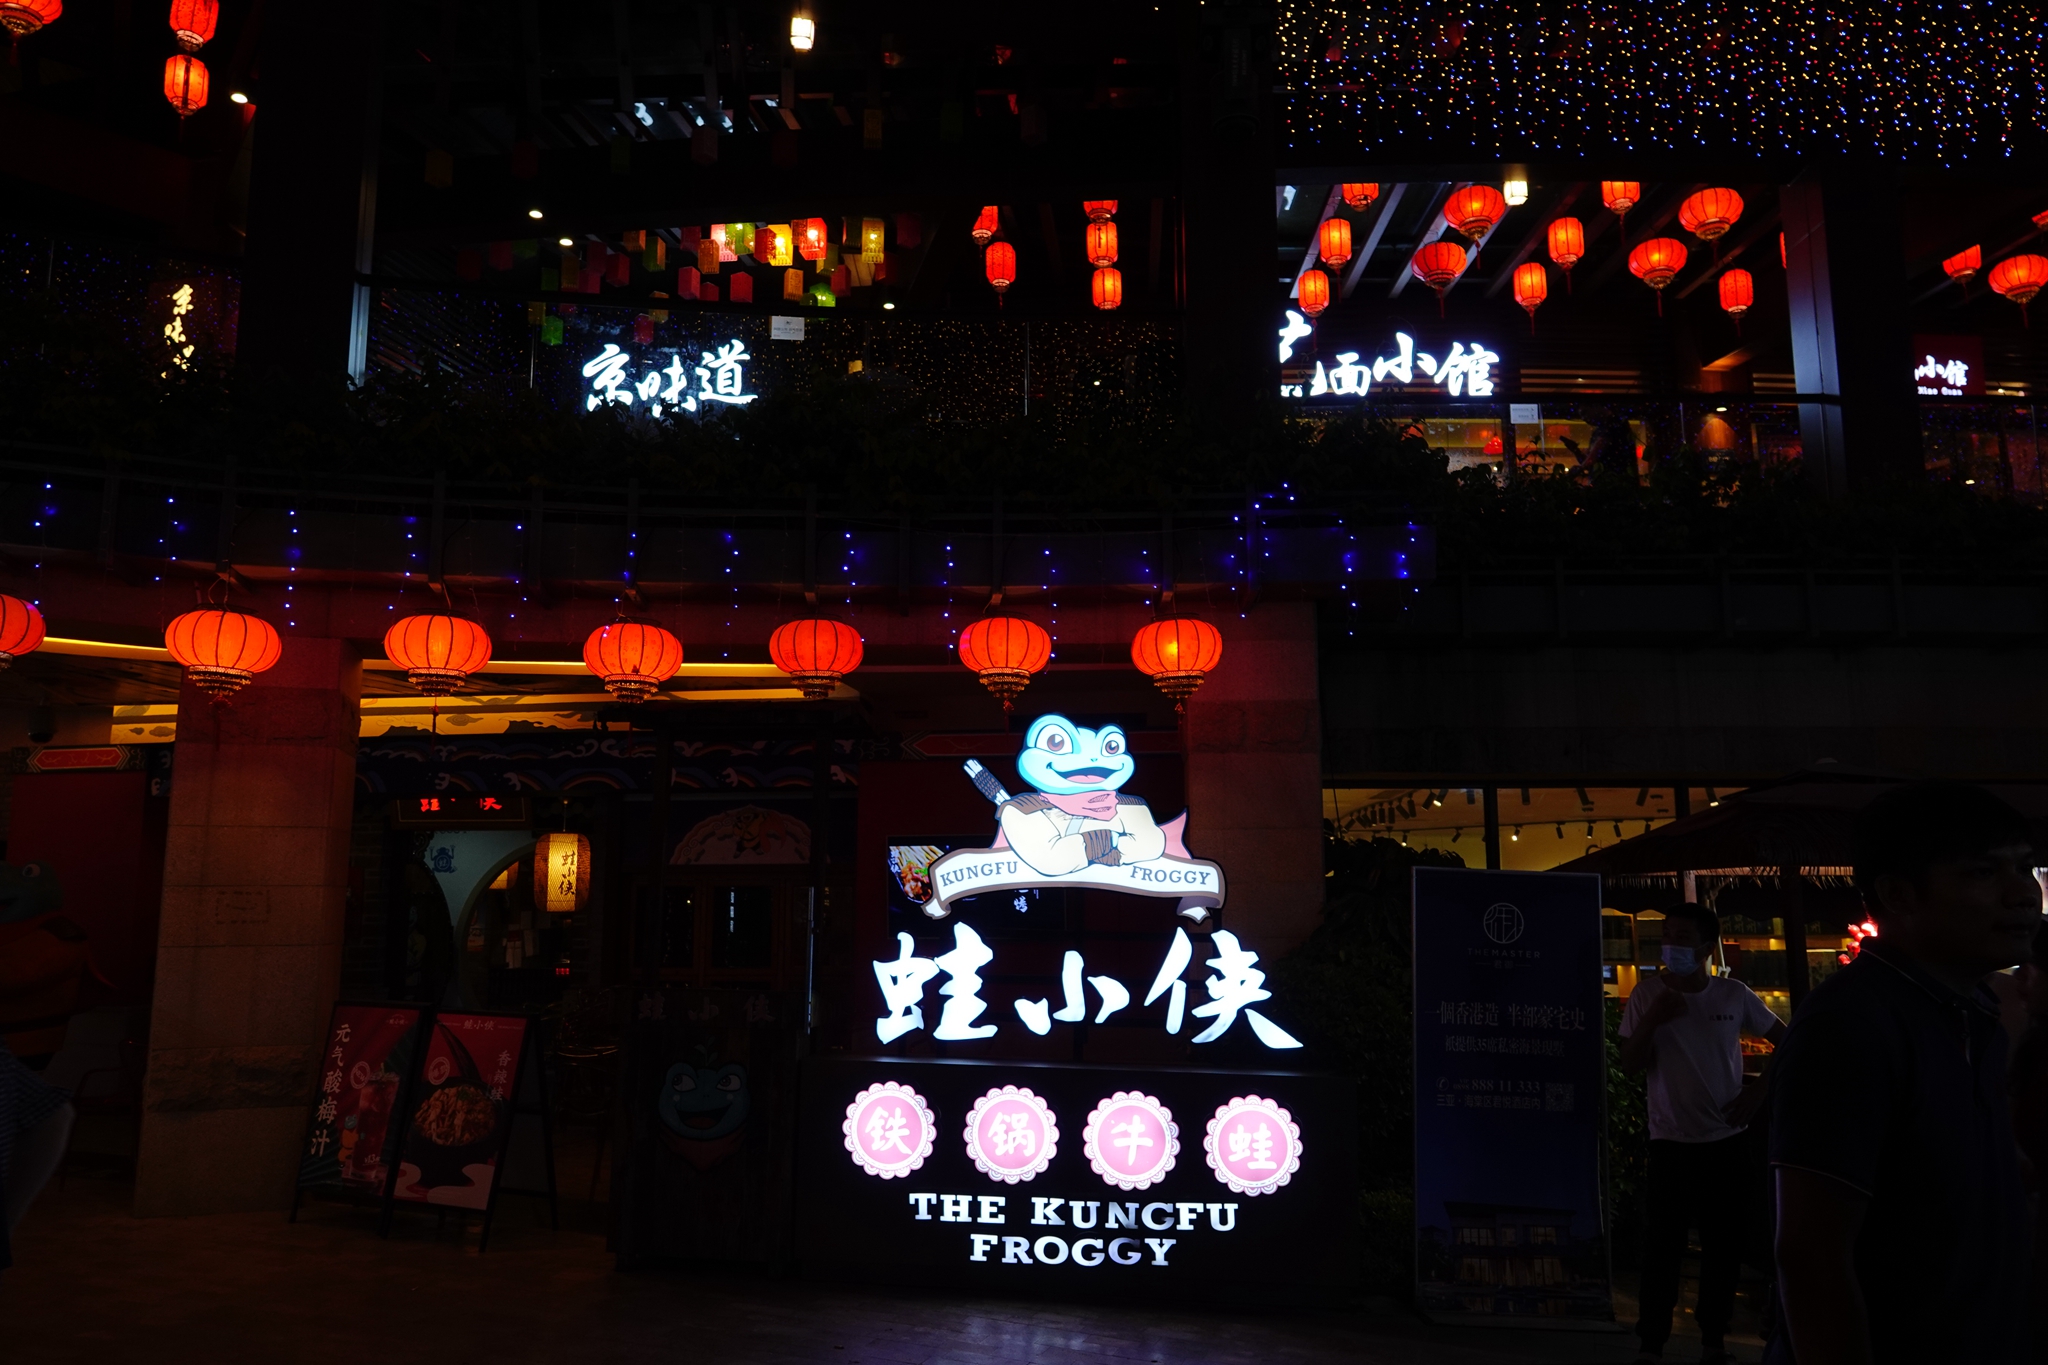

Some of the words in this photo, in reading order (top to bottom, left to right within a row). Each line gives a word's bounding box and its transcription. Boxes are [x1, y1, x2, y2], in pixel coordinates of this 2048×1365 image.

[582, 338, 759, 418] 京味道
[1914, 354, 1969, 387] 小馆
[558, 850, 576, 896] 蛙小侠
[940, 861, 1018, 887] KUNGFU
[1130, 866, 1211, 886] FROGGY
[873, 922, 1304, 1049] 蛙小侠
[1425, 1001, 1499, 1026] 一個香港造
[1508, 1003, 1586, 1031] 半部豪宅史
[310, 1023, 351, 1157] 元气酸梅汁
[1472, 1079, 1494, 1091] 888
[1500, 1080, 1512, 1092] 11
[1517, 1081, 1541, 1093] 333
[909, 1192, 1006, 1225] THE
[1031, 1197, 1239, 1231] KUNGFU
[970, 1233, 1177, 1266] FROGGY
